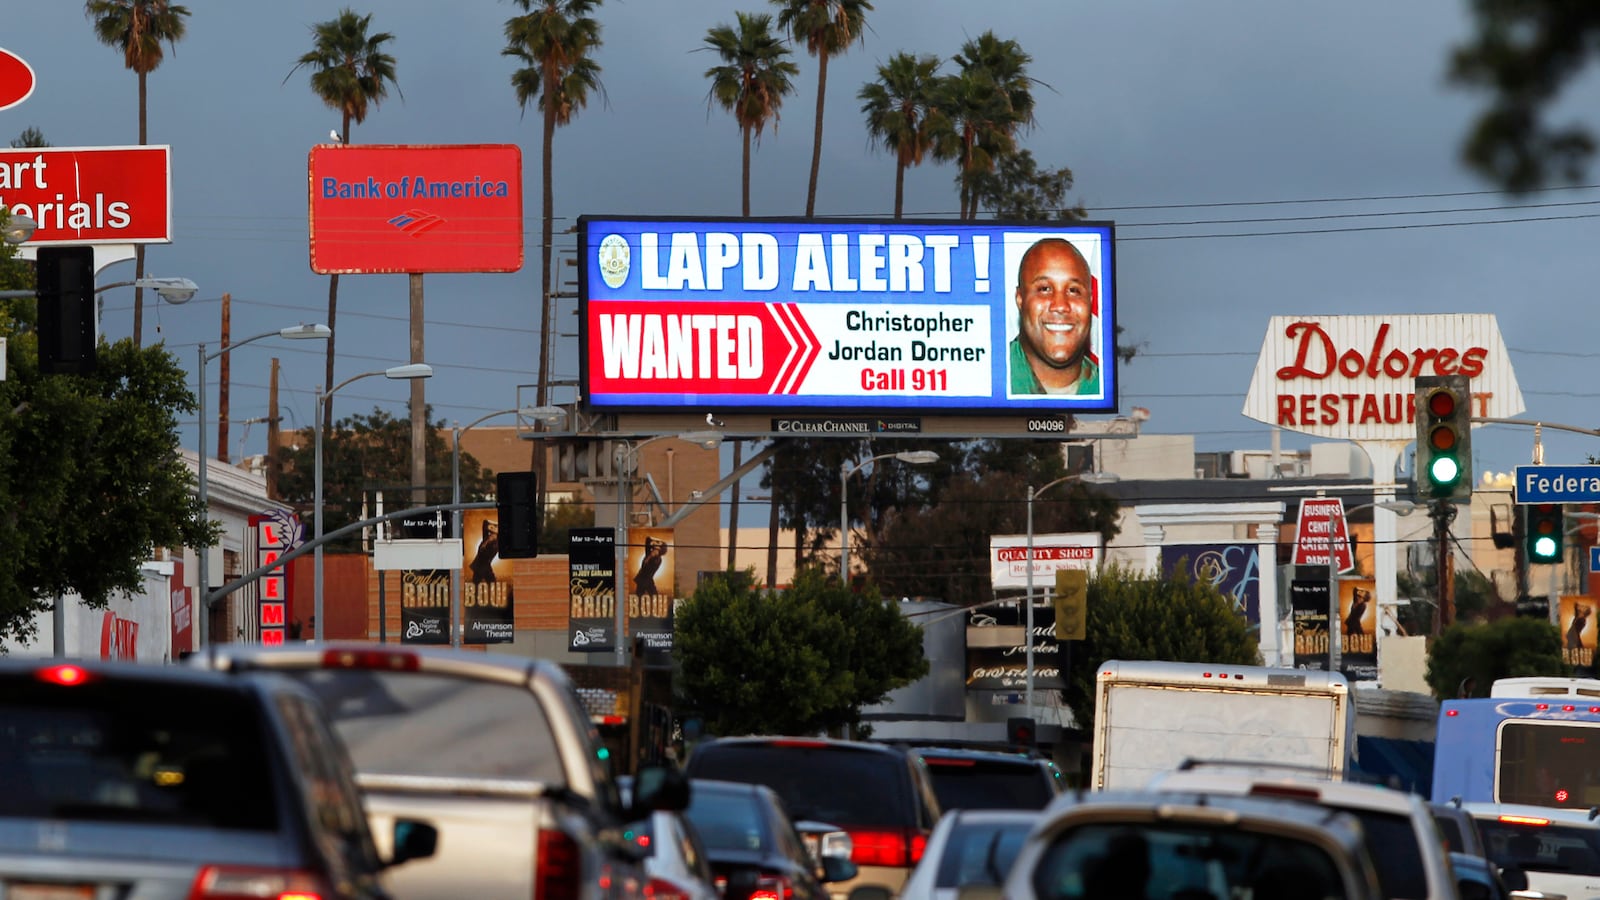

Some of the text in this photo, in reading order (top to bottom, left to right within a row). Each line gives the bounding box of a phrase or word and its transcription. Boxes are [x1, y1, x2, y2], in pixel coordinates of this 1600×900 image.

[322, 176, 508, 199] Bank of America
[640, 231, 990, 293] LAPD ALERT !
[845, 310, 974, 335] Christopher
[599, 313, 764, 380] WANTED
[828, 338, 985, 362] Jordan Dorner
[1276, 320, 1489, 380] Dolores
[860, 368, 947, 391] Call 911
[1277, 392, 1493, 426] RESTAUT
[1028, 419, 1065, 432] 004096
[1304, 504, 1341, 517] BUSINESS
[571, 535, 583, 543] Mar
[1300, 536, 1345, 551] CATERNG
[1059, 548, 1092, 559] SHOE
[403, 583, 449, 608] RAIN
[464, 582, 507, 608] BOW
[571, 577, 604, 597] End
[571, 594, 614, 618] RAIN
[629, 594, 668, 618] BOW
[472, 621, 513, 630] Ahmanson
[485, 630, 513, 638] Theatre
[636, 632, 672, 640] Ahmanson
[647, 639, 673, 647] Theatre
[1295, 634, 1329, 654] RAIN
[1341, 633, 1373, 654] BOW
